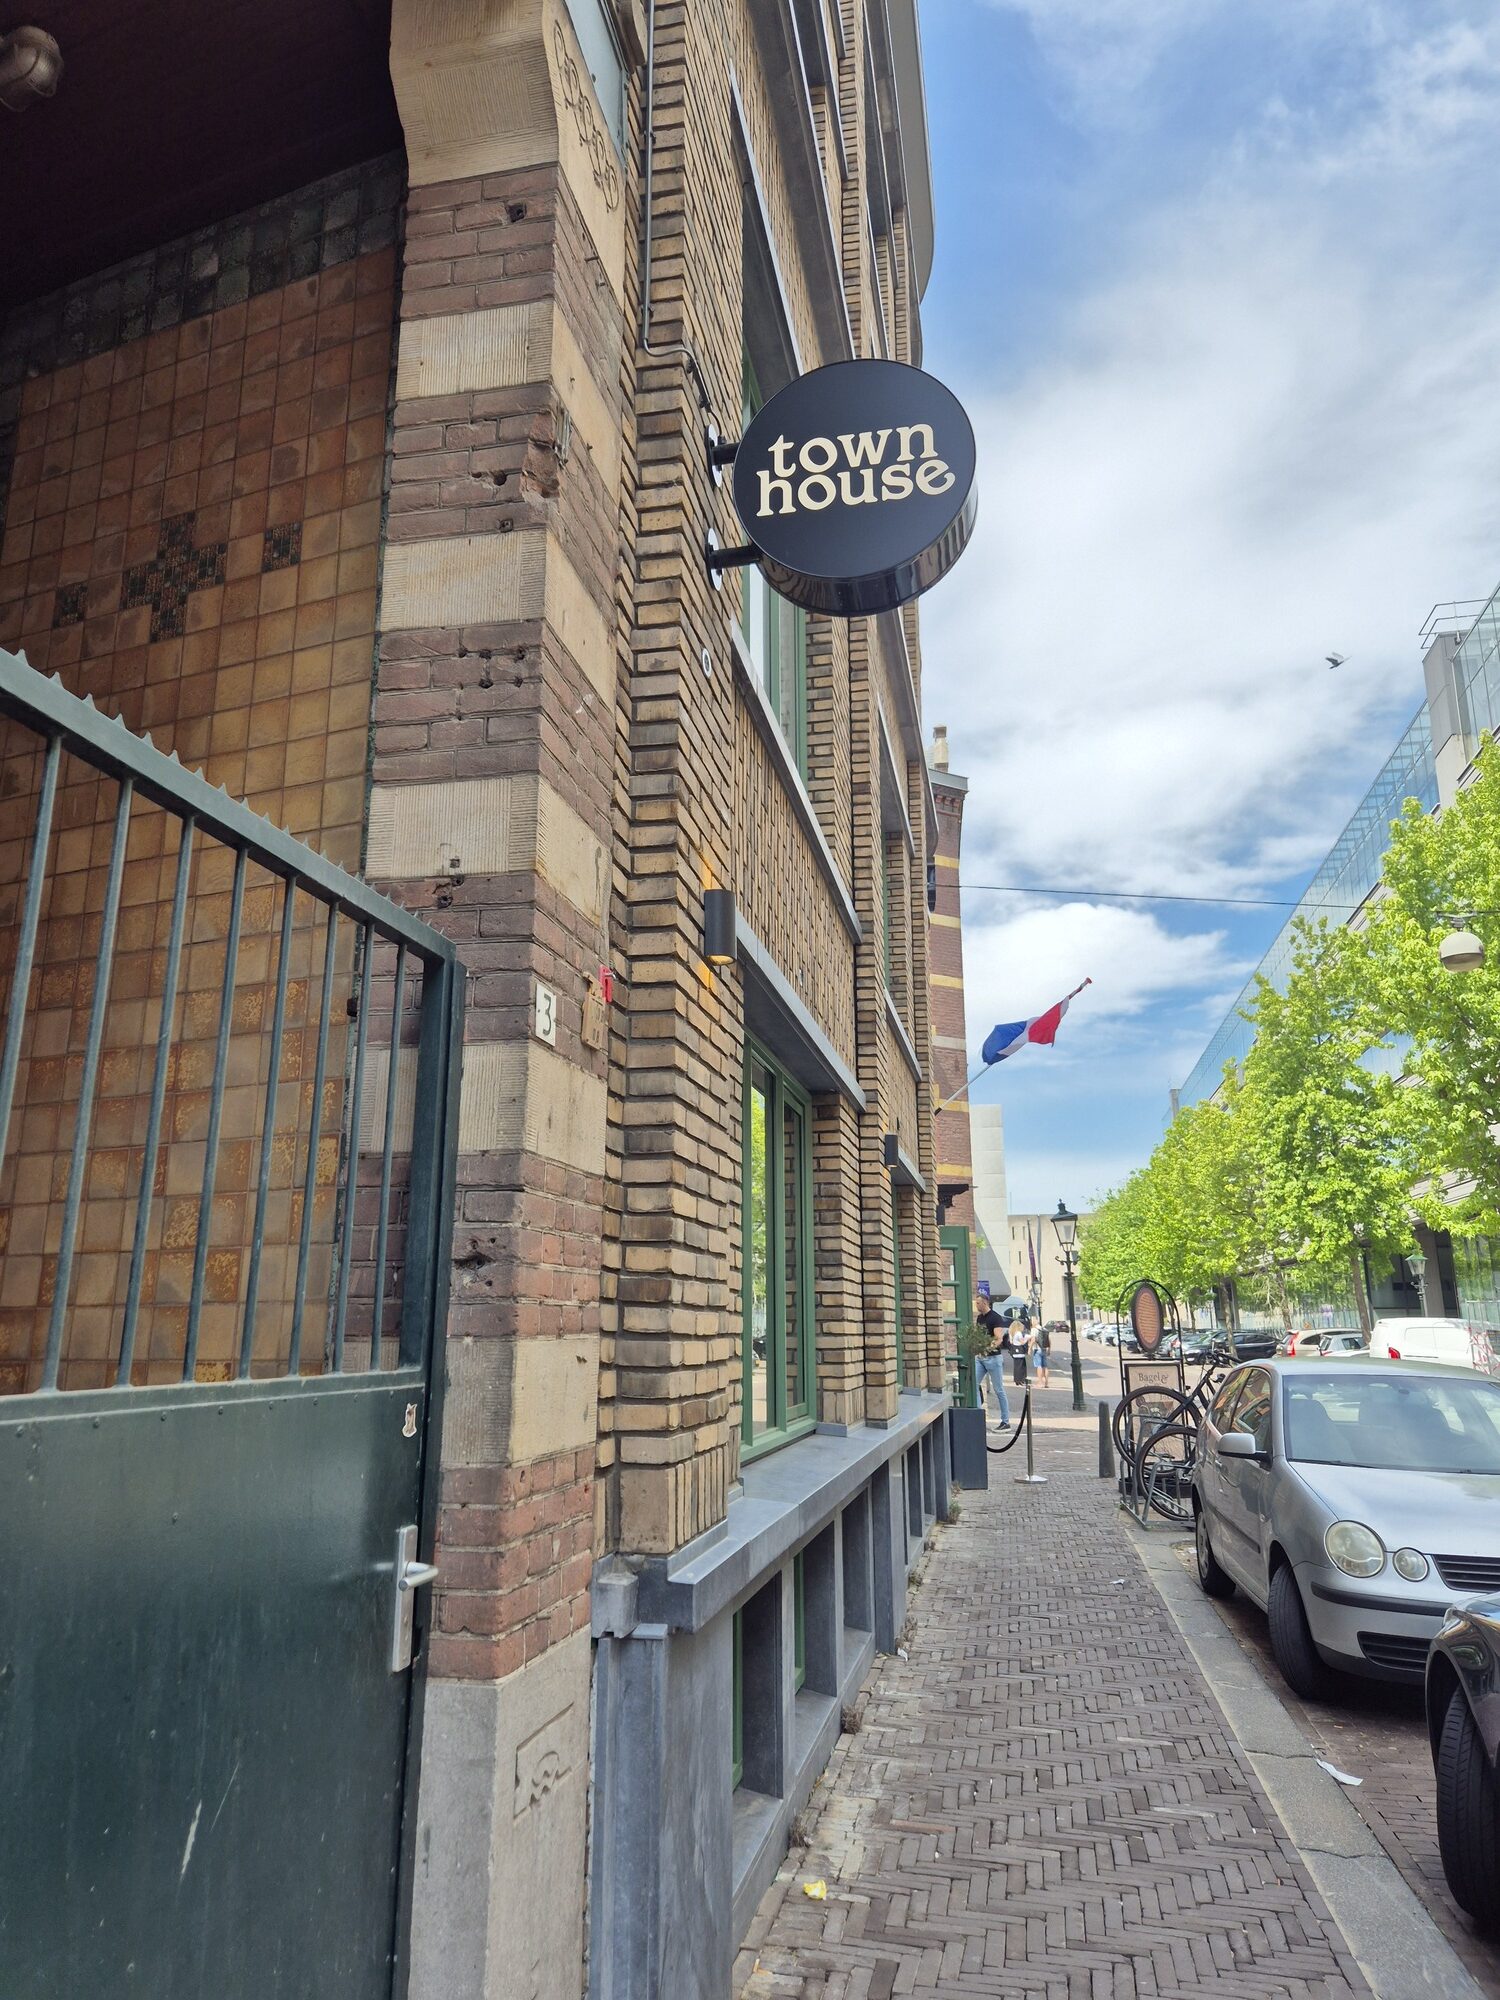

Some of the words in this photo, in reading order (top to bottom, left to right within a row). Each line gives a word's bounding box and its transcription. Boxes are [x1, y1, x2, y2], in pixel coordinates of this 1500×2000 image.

[767, 423, 938, 478] town
[756, 459, 956, 517] house
[542, 993, 552, 1036] 3
